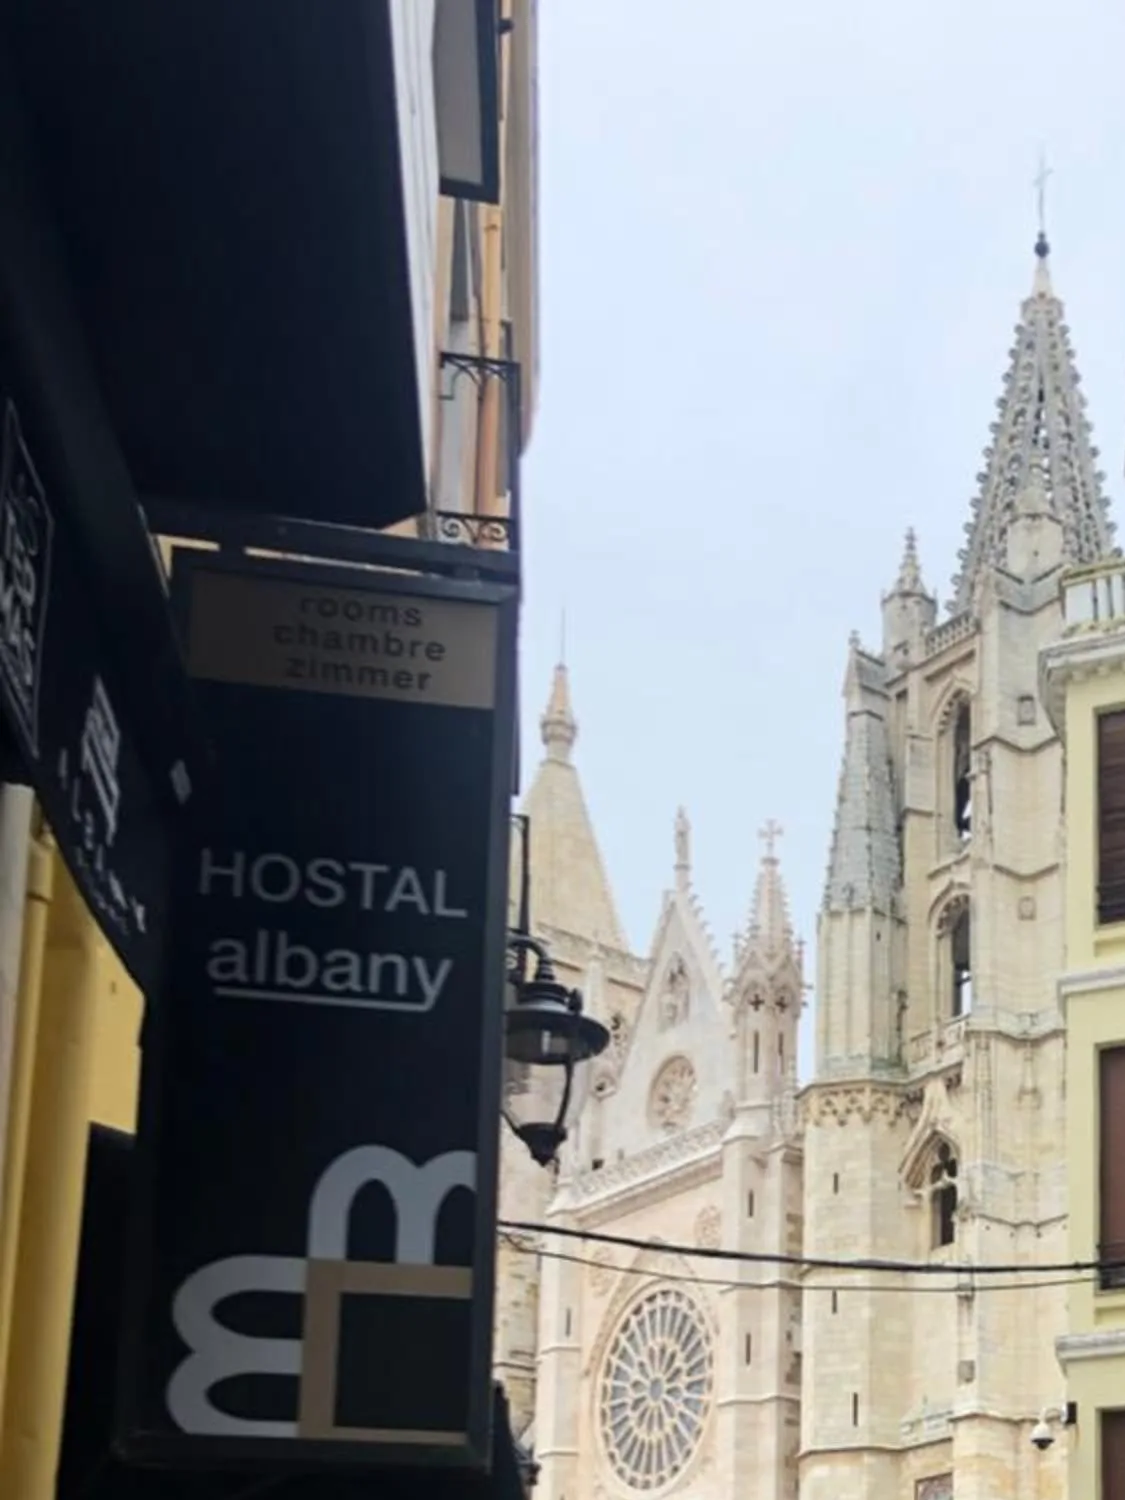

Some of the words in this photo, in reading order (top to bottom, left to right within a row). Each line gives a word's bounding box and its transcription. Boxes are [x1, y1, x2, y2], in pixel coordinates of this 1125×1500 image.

[300, 596, 422, 628] rooms
[272, 622, 447, 662] chambre
[285, 657, 433, 692] zimmer
[199, 847, 469, 918] HOSTAL
[206, 928, 454, 1011] albany
